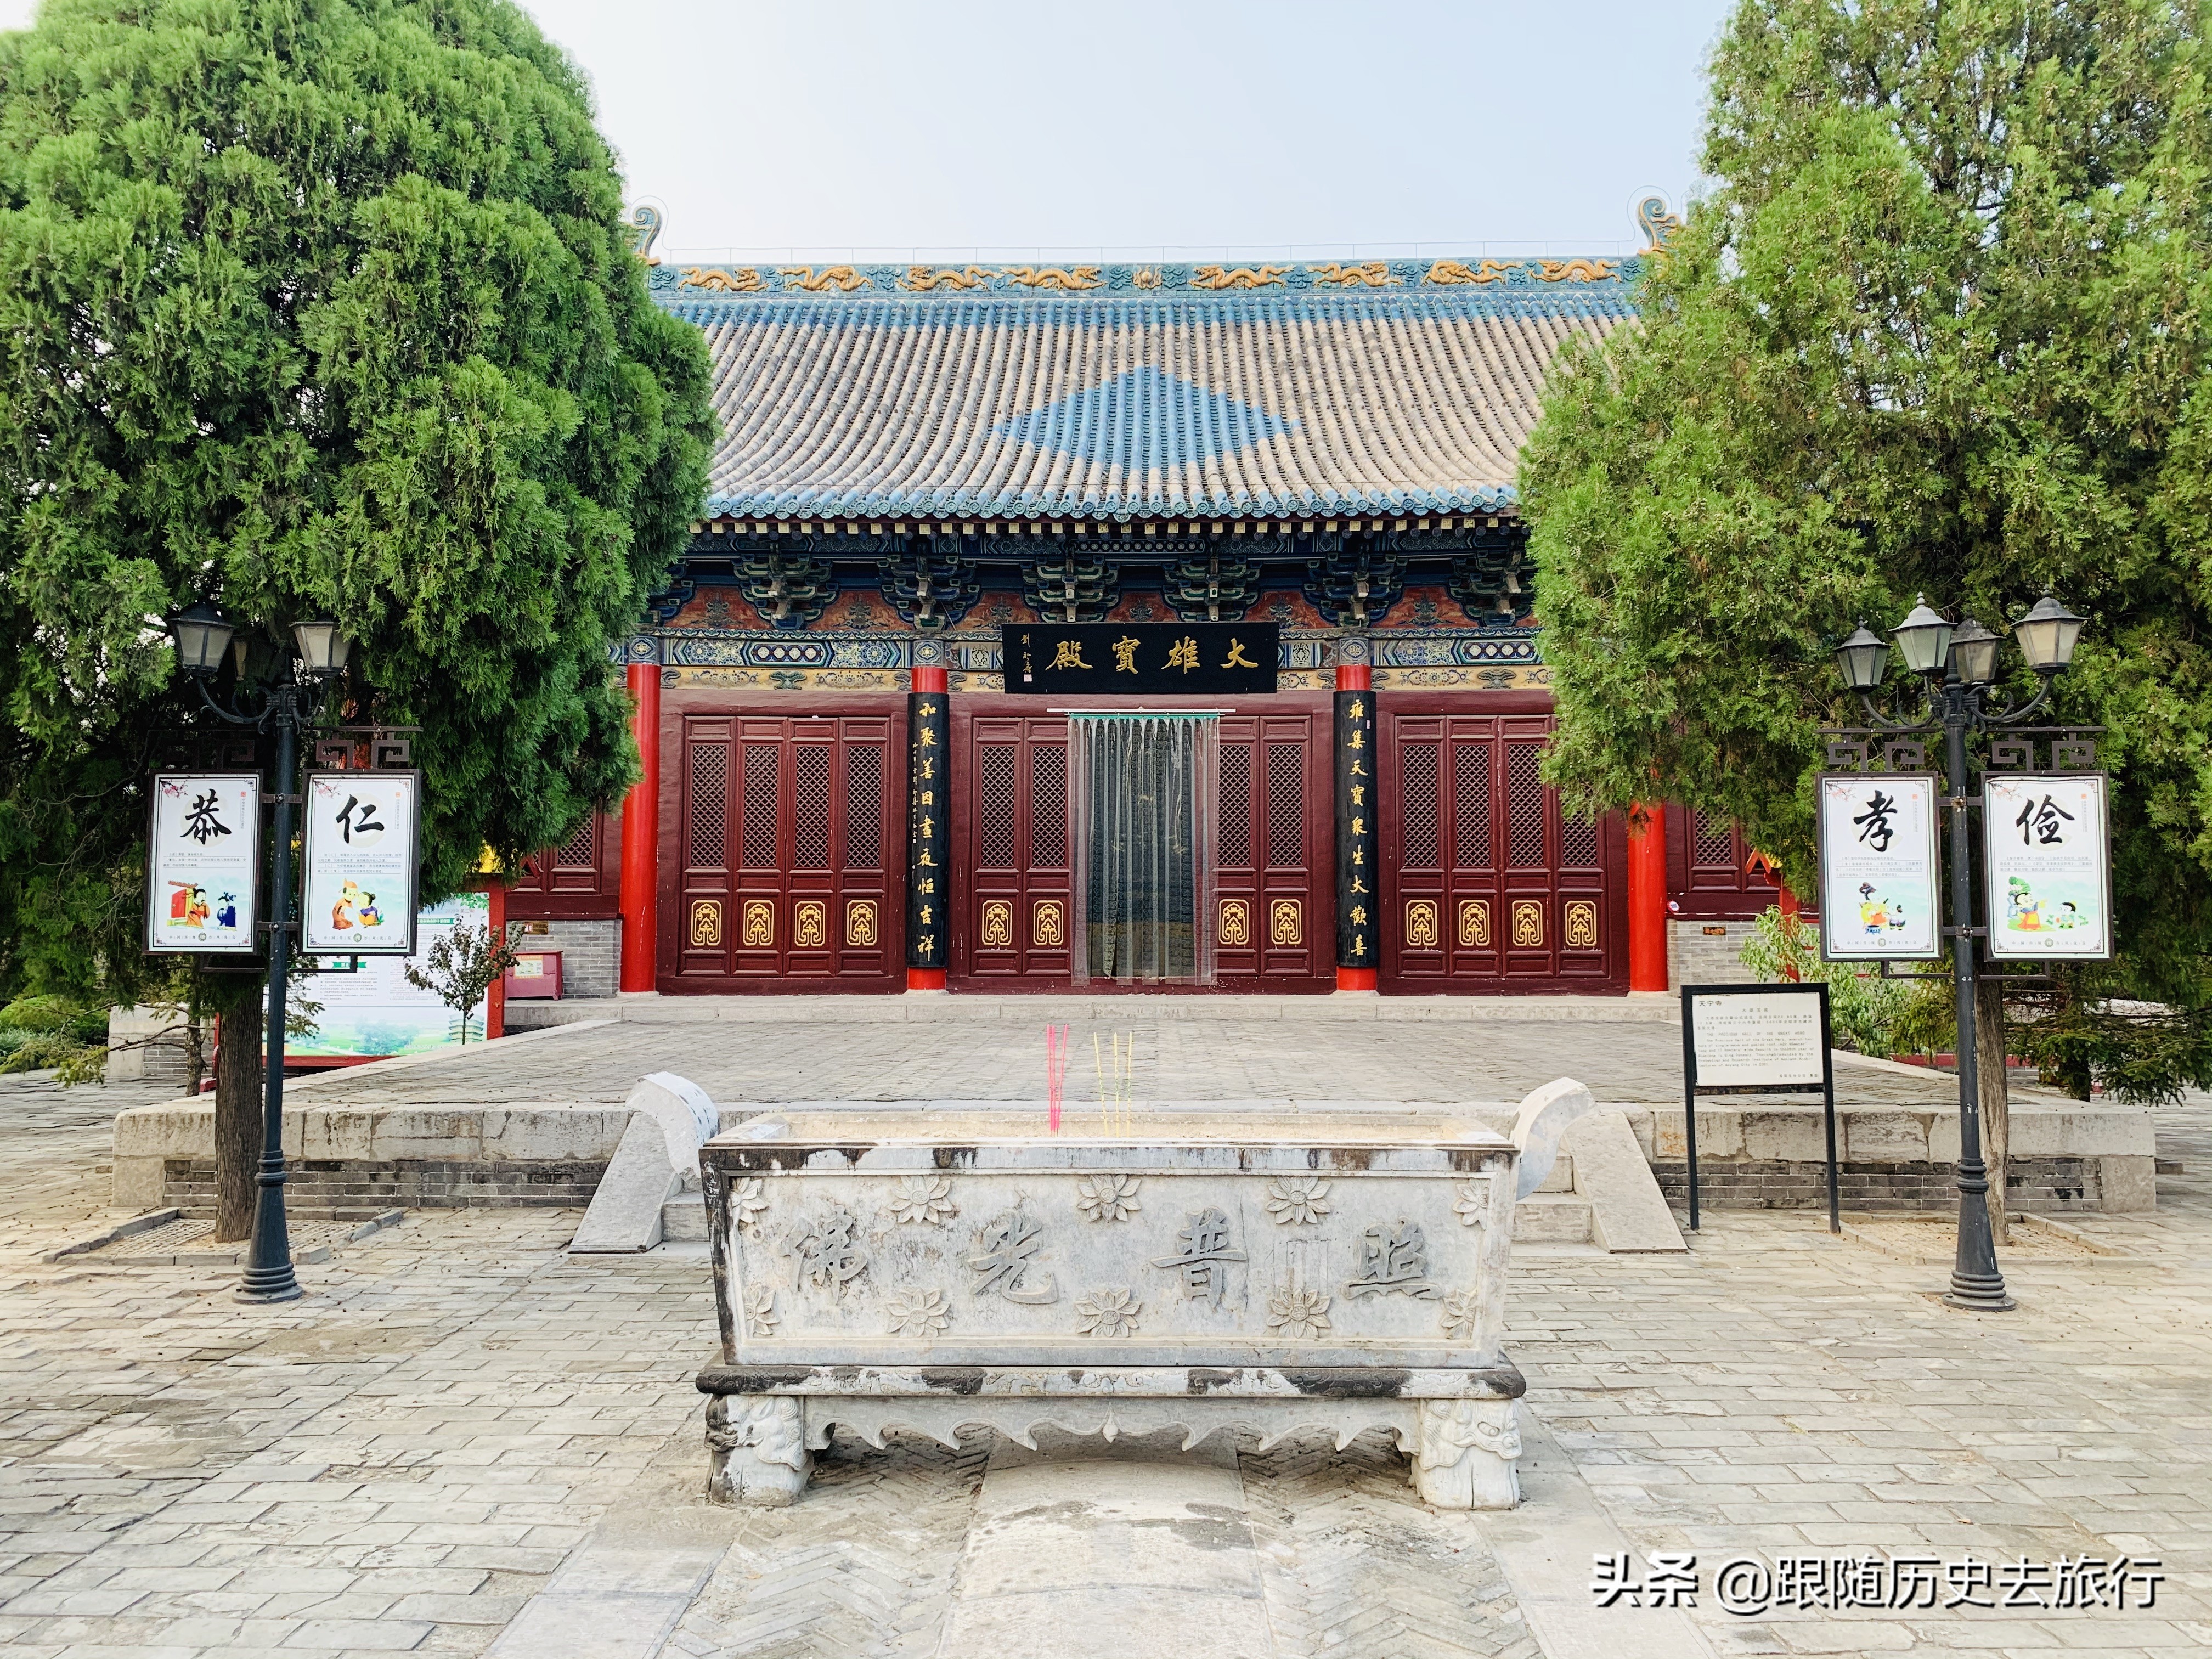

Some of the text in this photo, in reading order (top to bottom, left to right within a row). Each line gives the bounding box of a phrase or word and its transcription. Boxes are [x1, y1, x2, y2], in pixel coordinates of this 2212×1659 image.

[180, 788, 232, 845] 恭
[335, 793, 385, 845] 仁
[1853, 789, 1898, 853] 孝
[2016, 794, 2075, 846] 俭
[776, 1201, 1446, 1309] 佛光普照
